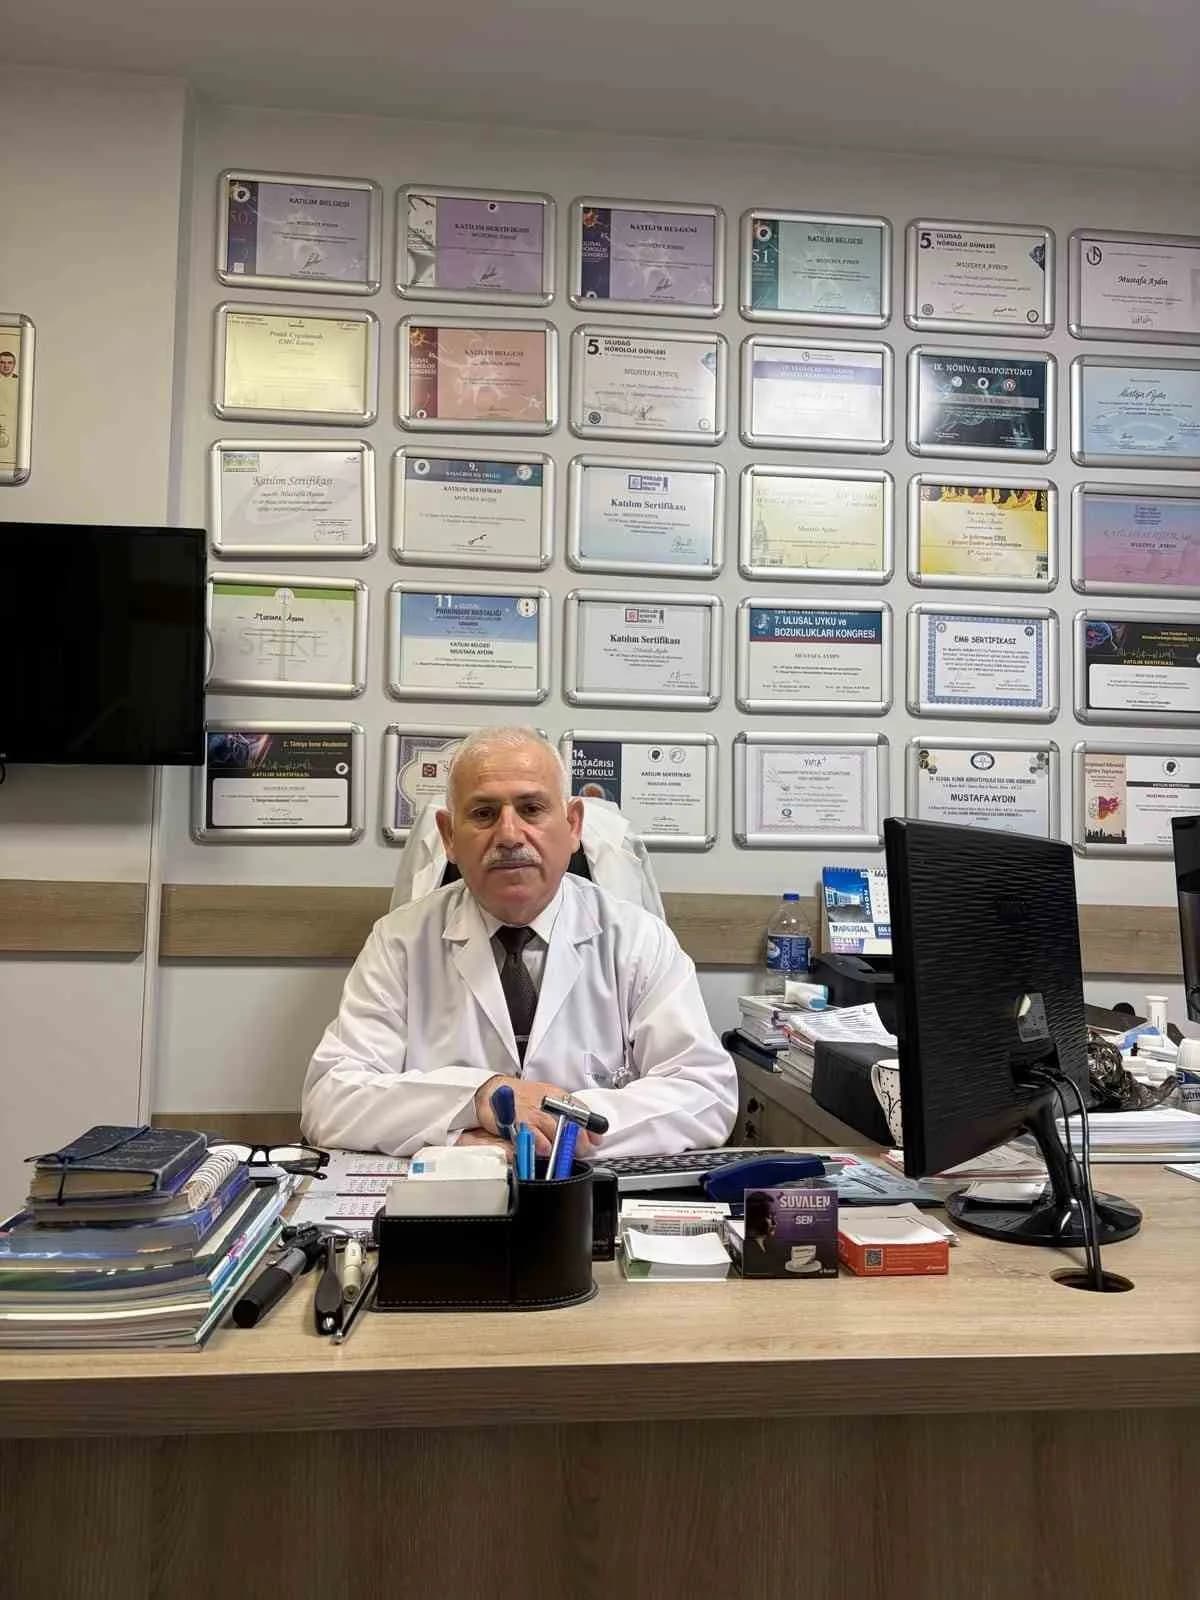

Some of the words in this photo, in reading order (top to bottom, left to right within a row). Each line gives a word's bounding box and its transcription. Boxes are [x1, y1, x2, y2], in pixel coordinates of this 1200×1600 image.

[920, 232, 935, 249] 5.
[586, 339, 603, 356] 5.
[774, 615, 782, 625] 7.
[783, 616, 813, 626] ULUSAL
[814, 616, 836, 626] UYKU
[837, 618, 847, 626] ve
[774, 627, 834, 638] BOZUKLUKLARI
[835, 627, 876, 639] KONGRESİ
[572, 749, 587, 760] 14.
[586, 769, 615, 777] OKULU
[950, 793, 990, 803] MUSTAFA
[991, 795, 1016, 804] AYDIN
[779, 1195, 831, 1209] SUVALEN
[795, 1214, 815, 1226] SEN
